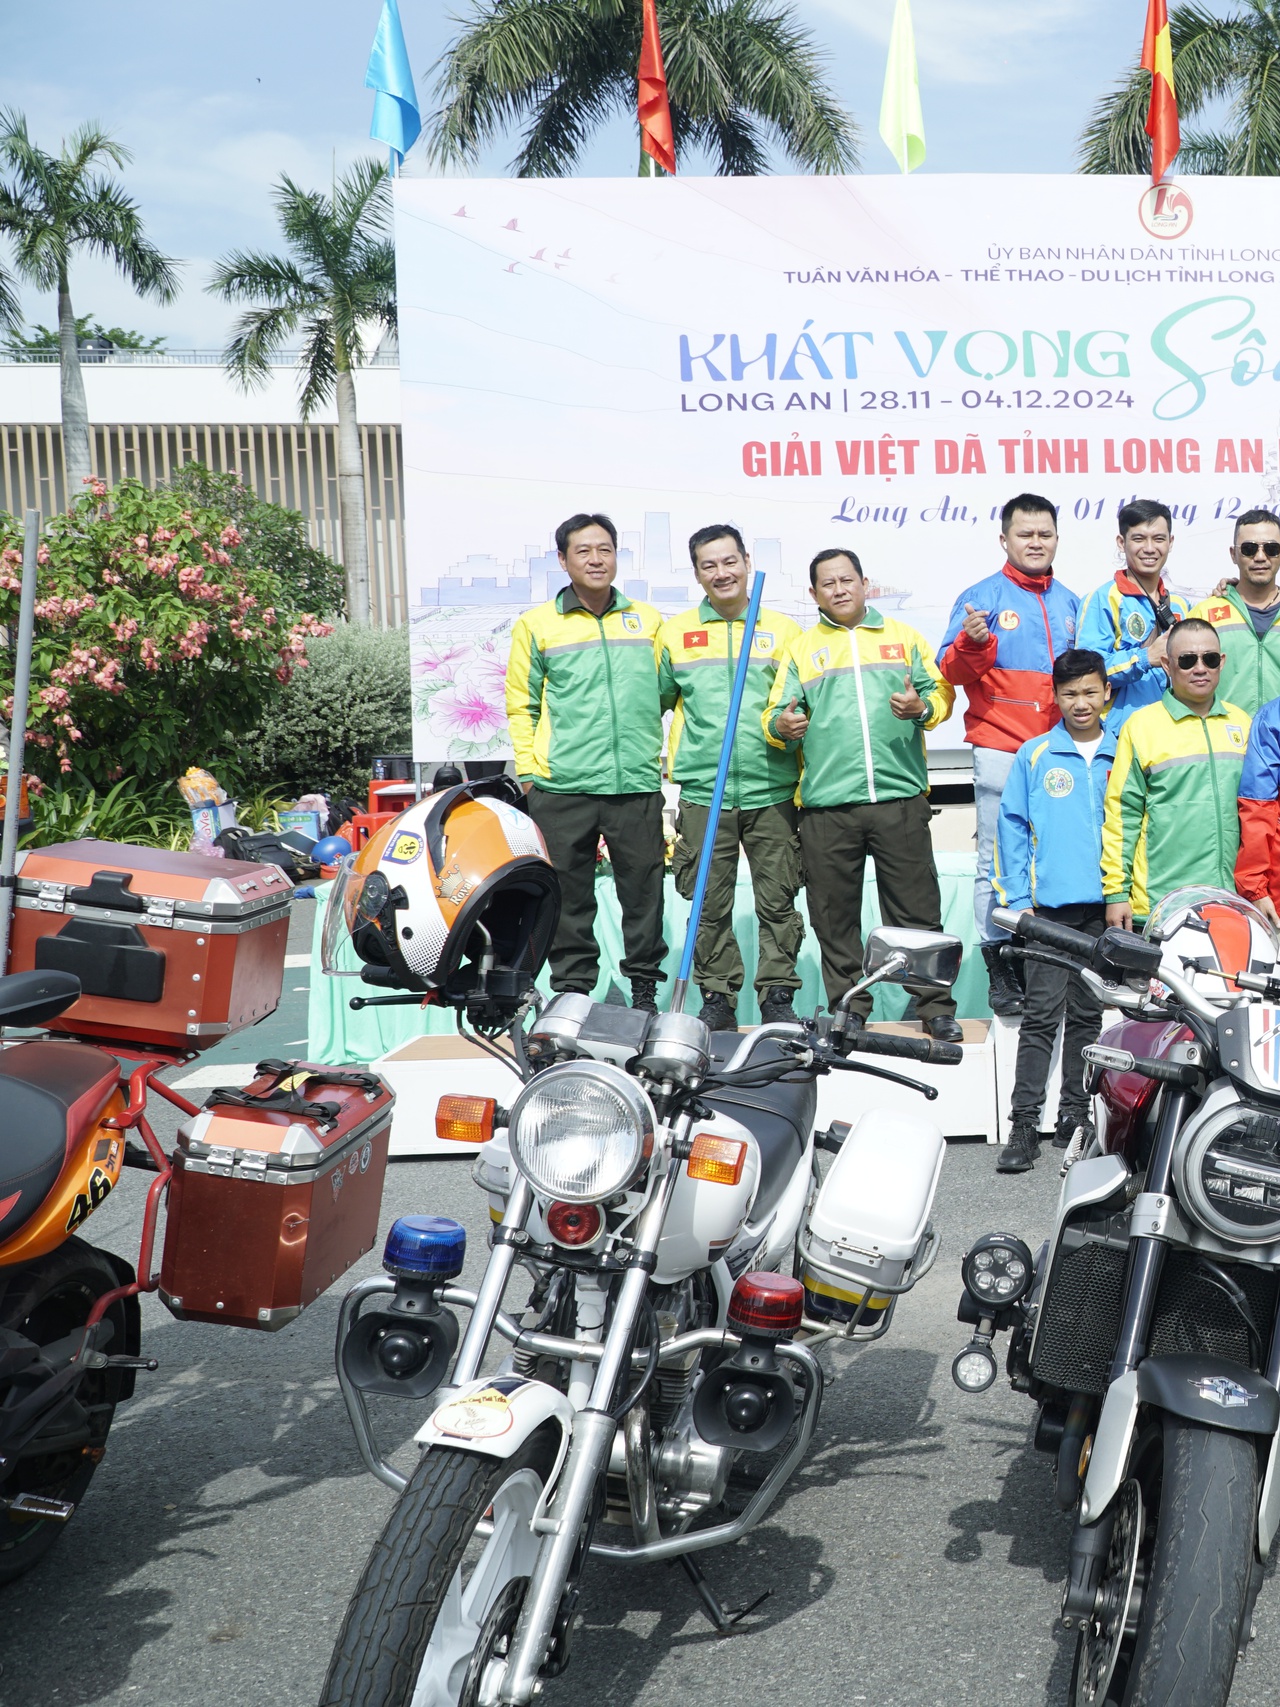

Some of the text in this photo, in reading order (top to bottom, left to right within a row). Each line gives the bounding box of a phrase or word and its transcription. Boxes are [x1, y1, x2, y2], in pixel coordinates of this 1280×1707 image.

[987, 242, 1014, 260] ỦY
[1019, 247, 1061, 260] BAN
[1065, 244, 1125, 260] NHÂN
[1130, 245, 1173, 261] DÂN
[1177, 244, 1225, 262] TỈNH
[783, 265, 842, 284] TUẦN
[846, 267, 890, 283] VĂN
[894, 266, 940, 283] HÓA
[960, 263, 1001, 282] THỂ
[1005, 269, 1064, 282] THAO
[1082, 269, 1110, 282] DU
[1114, 269, 1161, 285] LỊCH
[1165, 266, 1214, 283] TỈNH
[1218, 270, 1275, 283] LONG
[679, 318, 875, 382] KHÁT
[894, 329, 1131, 382] VỌNG
[680, 392, 775, 413] LONG
[784, 391, 832, 411] AN
[859, 390, 932, 410] 28.11
[960, 389, 1135, 410] 04.12.2024
[741, 432, 823, 478] GIẢI
[835, 433, 920, 483] VIỆT
[933, 433, 987, 476] DÃ
[998, 430, 1089, 475] TỈNH
[1103, 438, 1200, 474] LONG
[1214, 438, 1264, 474] AN
[830, 495, 910, 529] Long
[1074, 497, 1106, 521] 01
[1213, 497, 1242, 520] 12
[449, 879, 474, 906] Royal
[65, 1167, 113, 1234] 46
